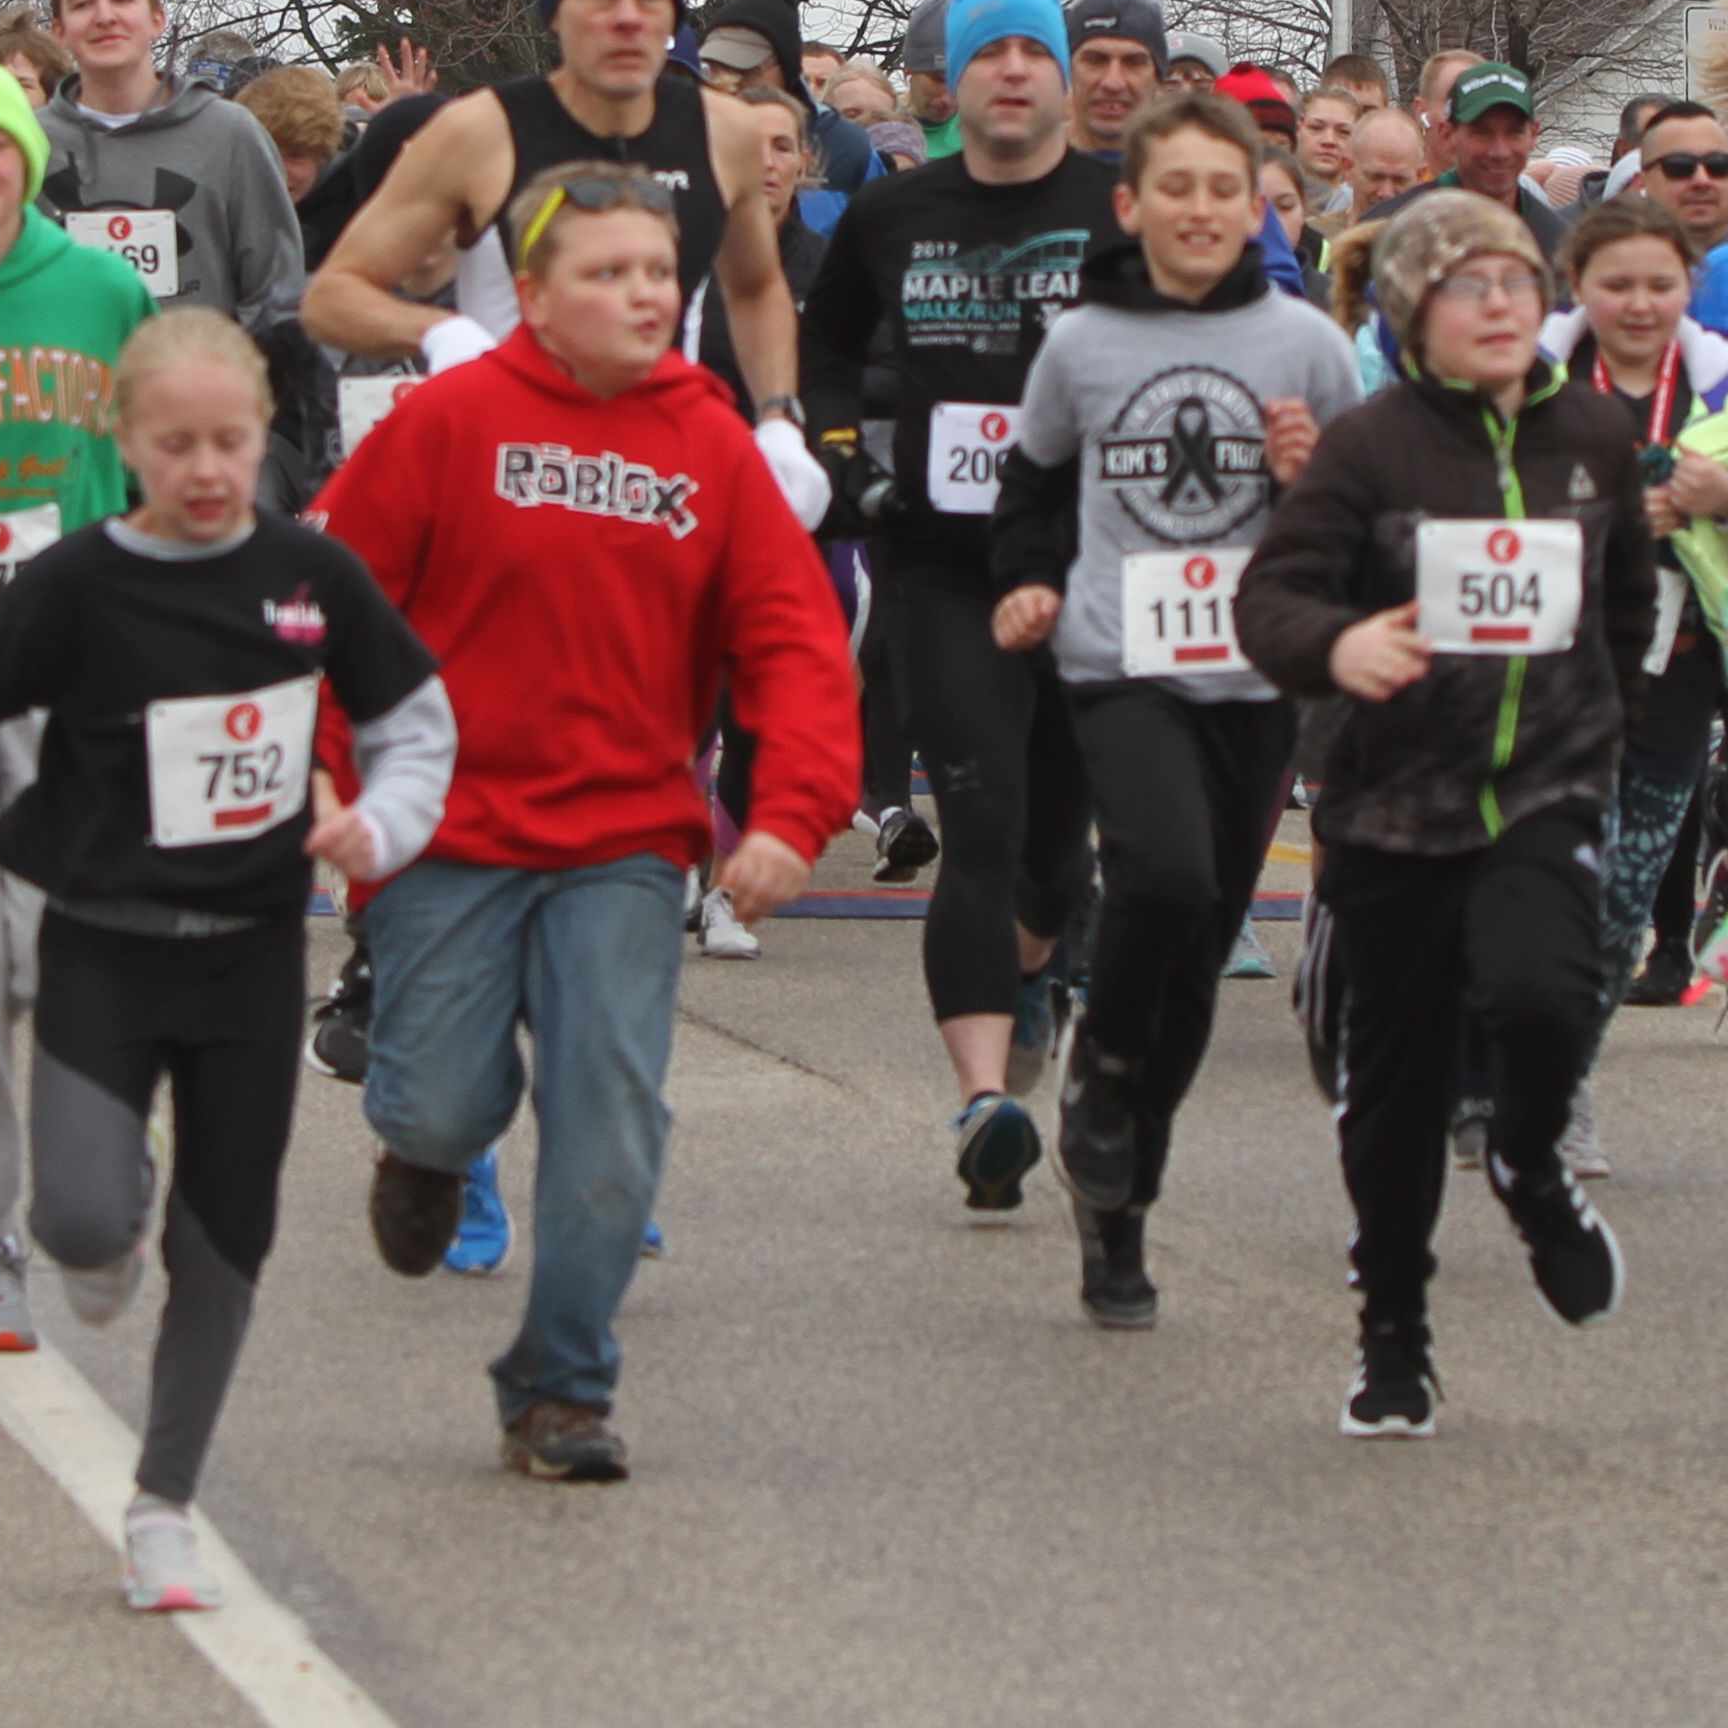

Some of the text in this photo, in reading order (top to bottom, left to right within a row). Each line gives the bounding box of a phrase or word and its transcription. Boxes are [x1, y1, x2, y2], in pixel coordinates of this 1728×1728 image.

[107, 244, 161, 274] 69
[911, 240, 959, 259] 2017
[902, 273, 1005, 302] MAPLE
[902, 301, 1021, 321] WALK/RUN
[1104, 441, 1168, 476] KIM'S
[1458, 571, 1543, 619] 504
[1148, 594, 1238, 640] 111
[197, 741, 286, 803] 752
